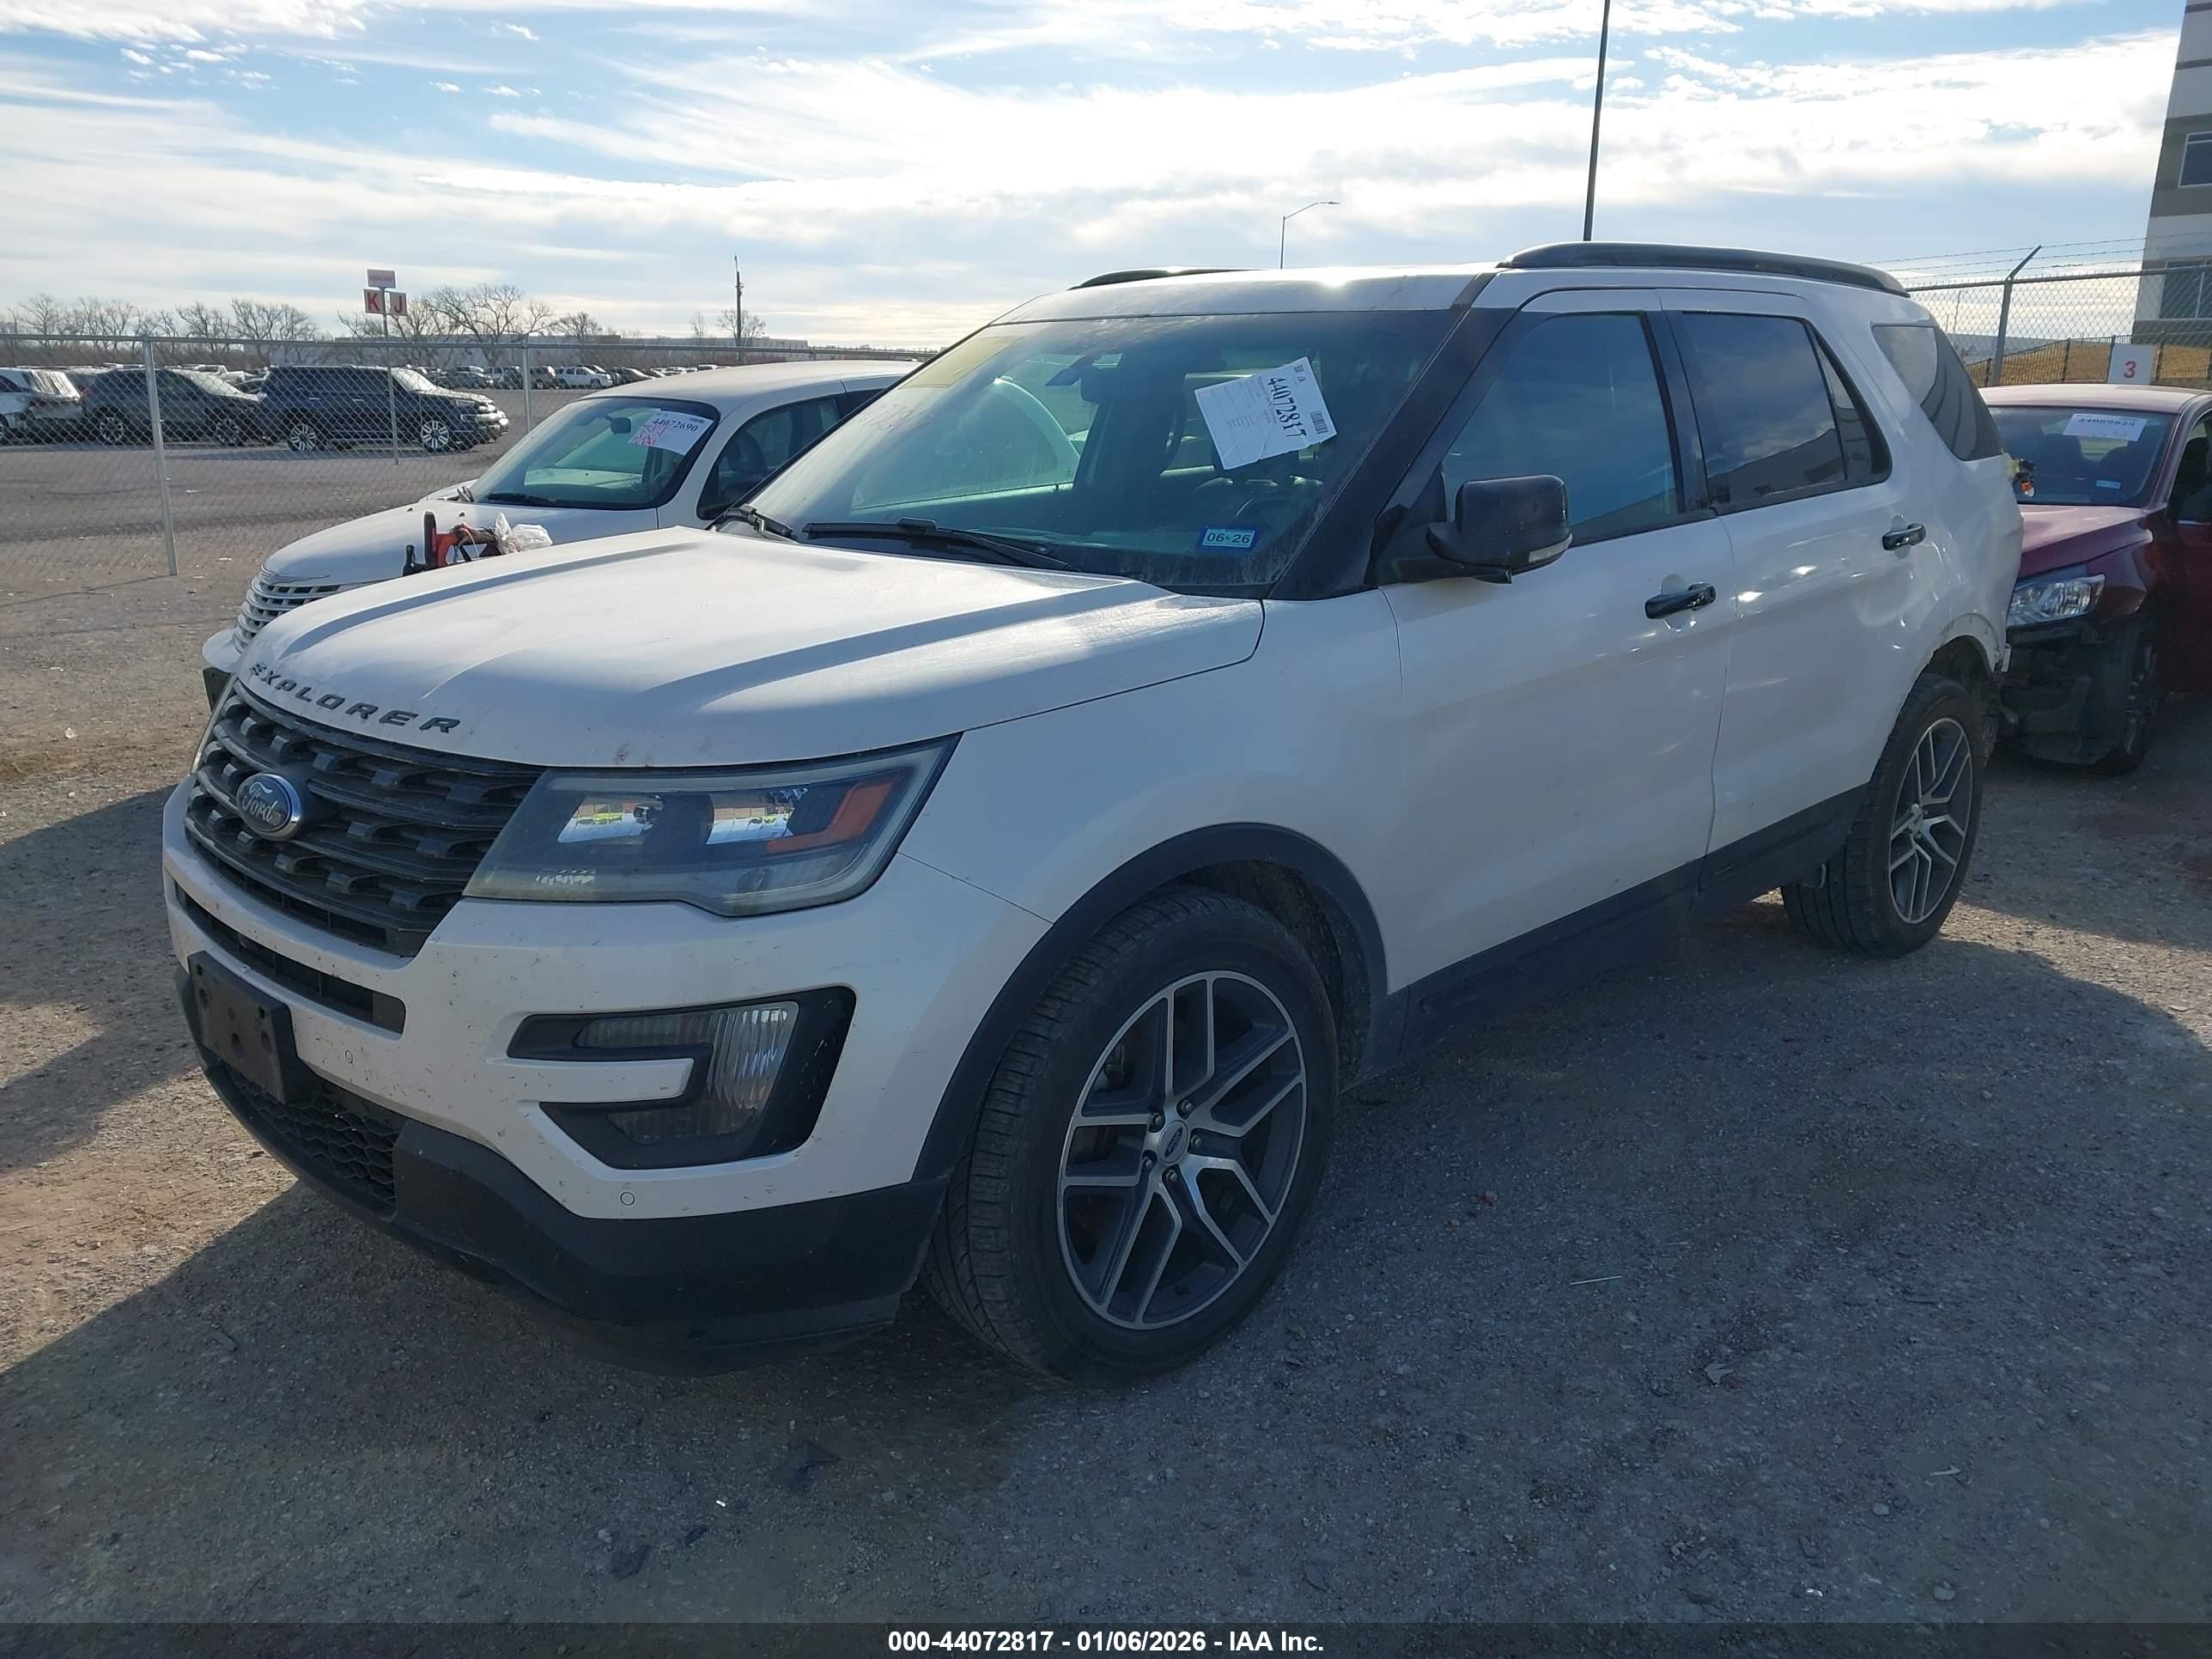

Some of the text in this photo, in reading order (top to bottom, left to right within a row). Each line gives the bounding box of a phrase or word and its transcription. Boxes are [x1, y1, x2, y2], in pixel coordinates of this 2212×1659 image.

[367, 292, 380, 311] K
[394, 295, 403, 313] J
[2124, 360, 2137, 379] 3
[1267, 377, 1307, 437] 44072817
[653, 418, 699, 432] 44072690
[1207, 532, 1251, 544] 06 26
[250, 661, 460, 733] EXPLORER
[242, 781, 279, 823] Ford
